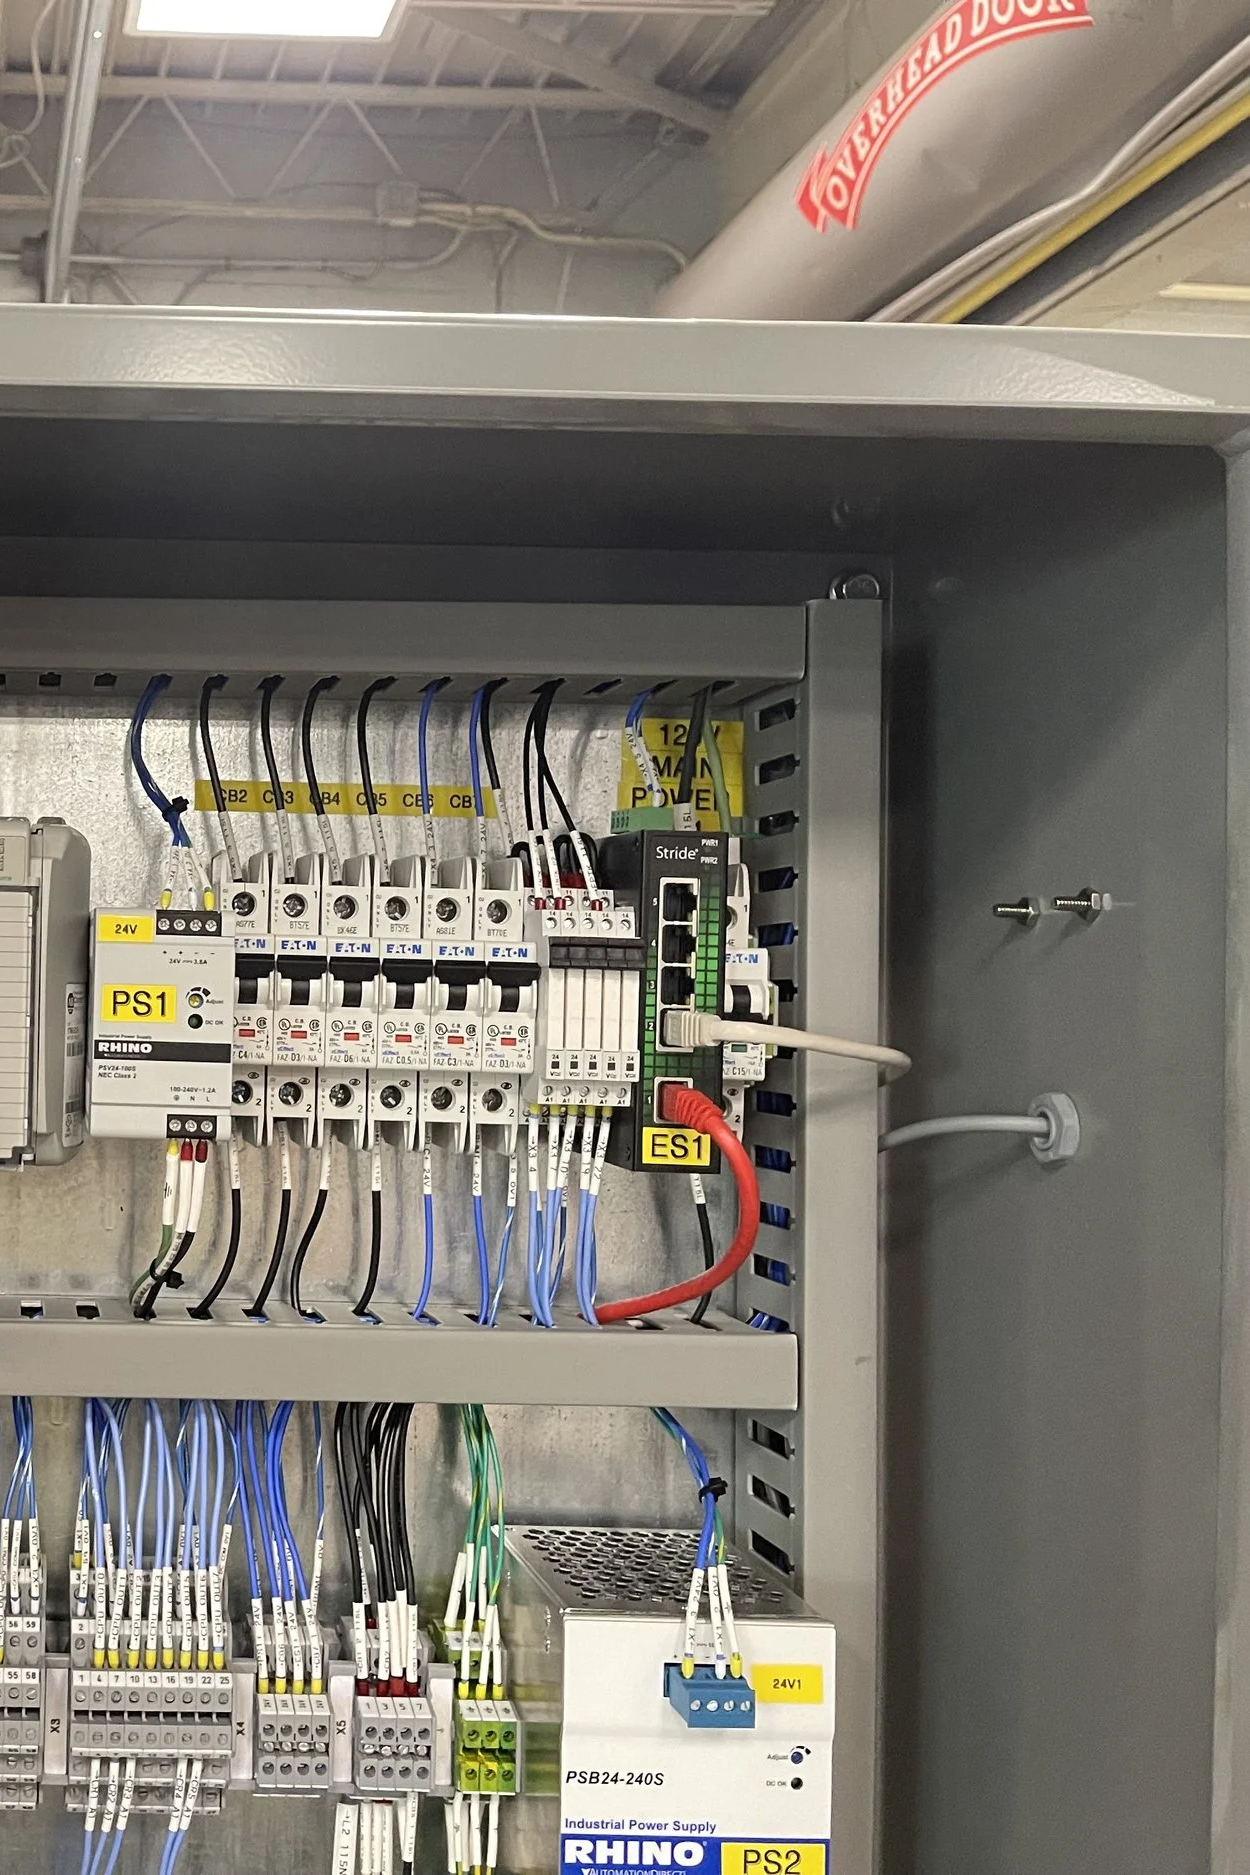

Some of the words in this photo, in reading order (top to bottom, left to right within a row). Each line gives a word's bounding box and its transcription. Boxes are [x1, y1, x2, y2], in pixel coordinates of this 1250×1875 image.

[825, 17, 962, 210] OVERHEAD
[652, 755, 711, 778] MAN
[262, 790, 294, 804] C3
[450, 794, 475, 808] CB
[702, 838, 718, 846] PWR1
[656, 846, 696, 860] Stride
[700, 856, 718, 864] PWR2
[652, 898, 658, 906] 5
[114, 924, 138, 934] 24V
[649, 981, 655, 989] 3
[112, 990, 167, 1018] PS1
[98, 1042, 153, 1054] RHINO
[647, 1096, 652, 1104] 1
[652, 1134, 702, 1160] ES1
[772, 1678, 802, 1690] 24V1
[50, 1718, 60, 1734] X3
[236, 1721, 245, 1736] X4
[336, 1720, 346, 1736] X5
[767, 1754, 789, 1762] Adjust
[566, 1770, 664, 1786] PSB24-240S
[565, 1818, 624, 1830] Industrial
[628, 1820, 668, 1831] Power
[672, 1820, 716, 1834] Supply
[565, 1840, 704, 1867] RHINO
[743, 1850, 801, 1875] PS2
